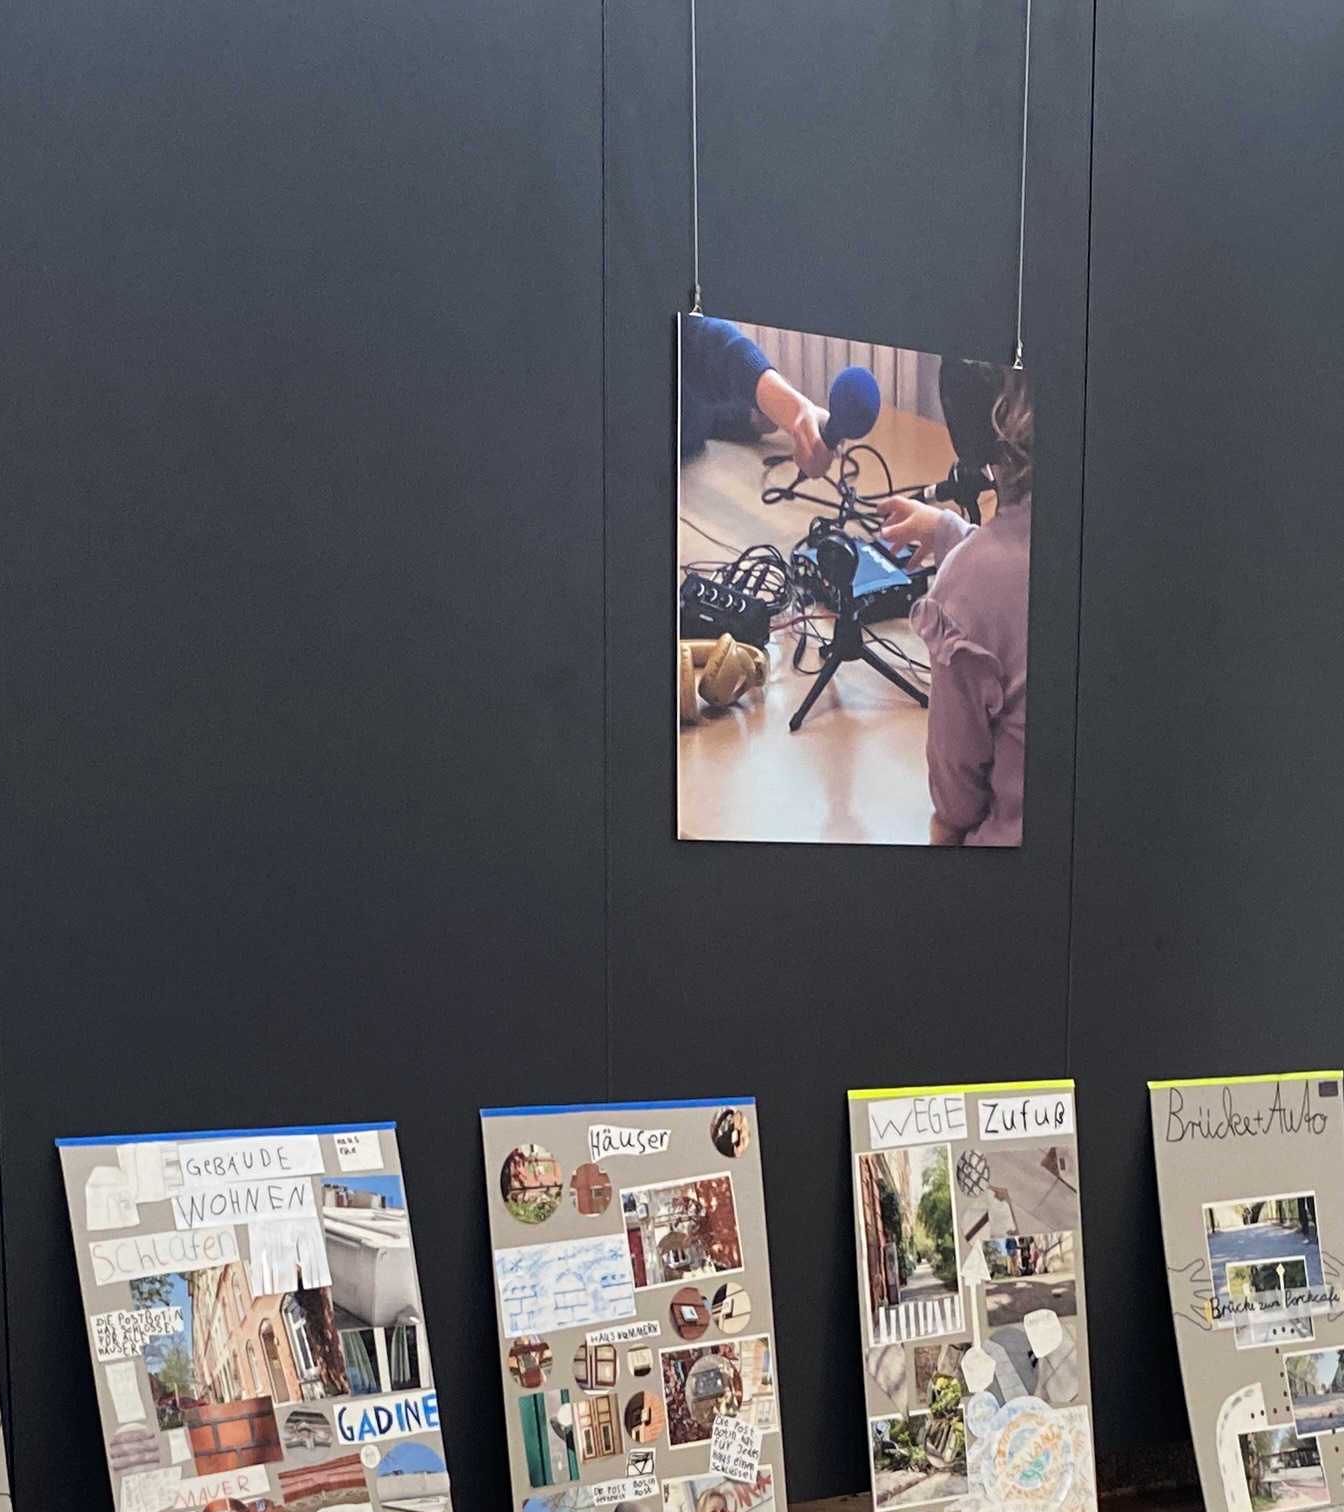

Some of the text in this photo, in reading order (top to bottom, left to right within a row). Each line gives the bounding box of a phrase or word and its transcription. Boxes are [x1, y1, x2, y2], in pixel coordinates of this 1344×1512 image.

[871, 1098, 965, 1139] WEGE
[590, 1129, 669, 1160] Häuser
[176, 1184, 305, 1228] WOHNEN
[338, 1393, 439, 1441] GADINE
[172, 1475, 250, 1509] MAUER
